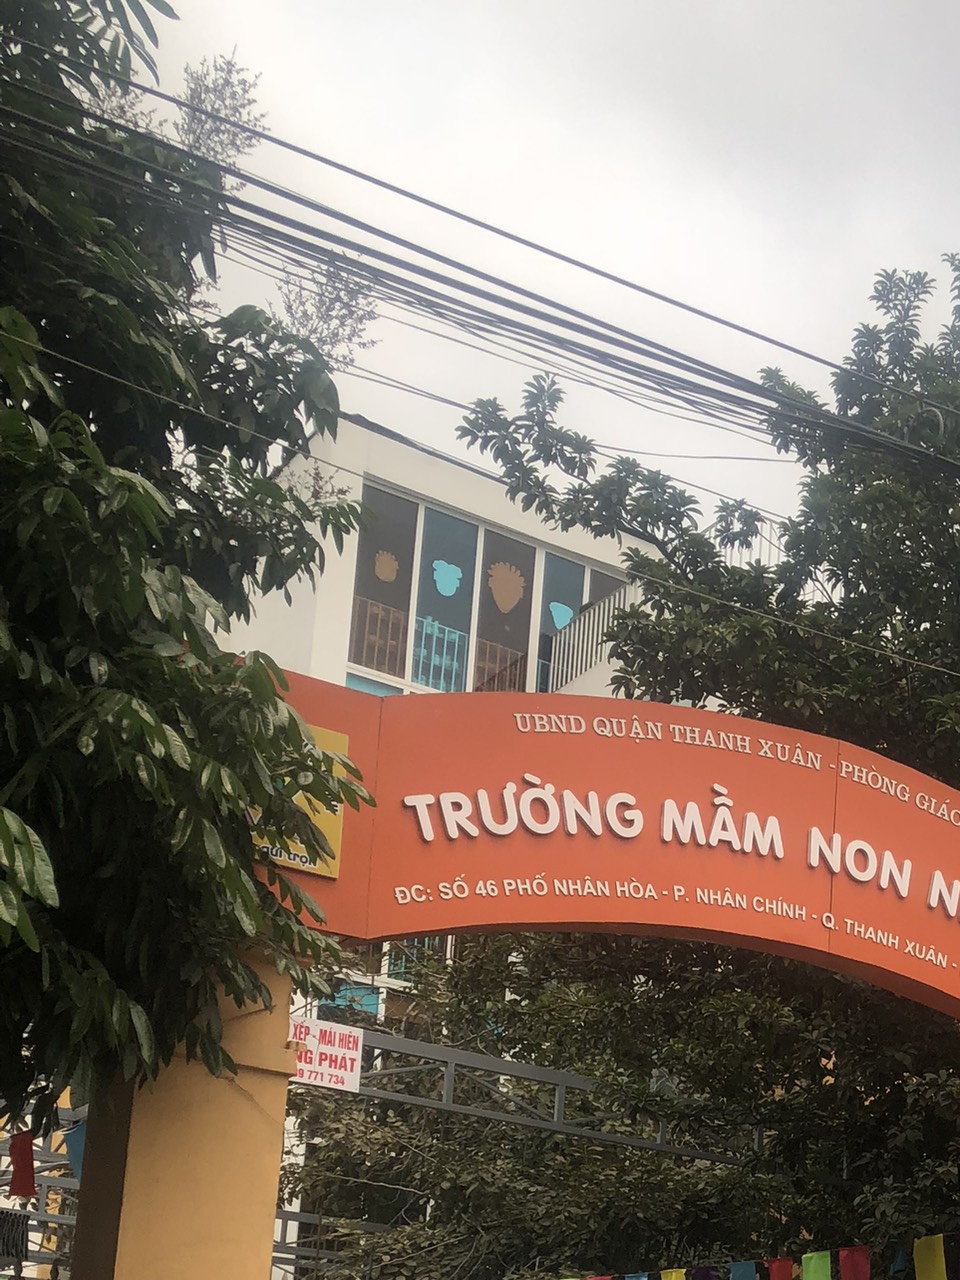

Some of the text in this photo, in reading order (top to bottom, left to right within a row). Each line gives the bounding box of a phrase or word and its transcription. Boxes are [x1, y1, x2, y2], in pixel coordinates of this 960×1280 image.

[513, 712, 587, 734] UBND
[592, 715, 664, 744] QUẬN
[669, 723, 752, 754] THANH
[757, 738, 823, 771] XUÂN
[840, 759, 912, 803] PHÒNG
[403, 772, 645, 843] TRƯỜNG
[661, 782, 785, 861] MẦM
[807, 826, 913, 899] NON
[394, 884, 434, 904] ĐC:
[438, 873, 470, 900] SỐ
[475, 879, 499, 897] 46
[503, 872, 548, 897] PHỐ
[553, 876, 610, 897] NHÂN
[616, 877, 658, 900] HÒA
[673, 885, 689, 902] P.
[696, 887, 748, 910] NHÂN
[752, 896, 807, 921] CHÍNH
[822, 912, 840, 931] Q.
[843, 918, 900, 950] THANH
[903, 938, 949, 969] XUÂN
[318, 1053, 357, 1073] PHÁT
[319, 1027, 336, 1048] MÁI
[338, 1031, 359, 1052] HIÊN
[307, 1069, 324, 1082] 771
[328, 1073, 345, 1086] 734
